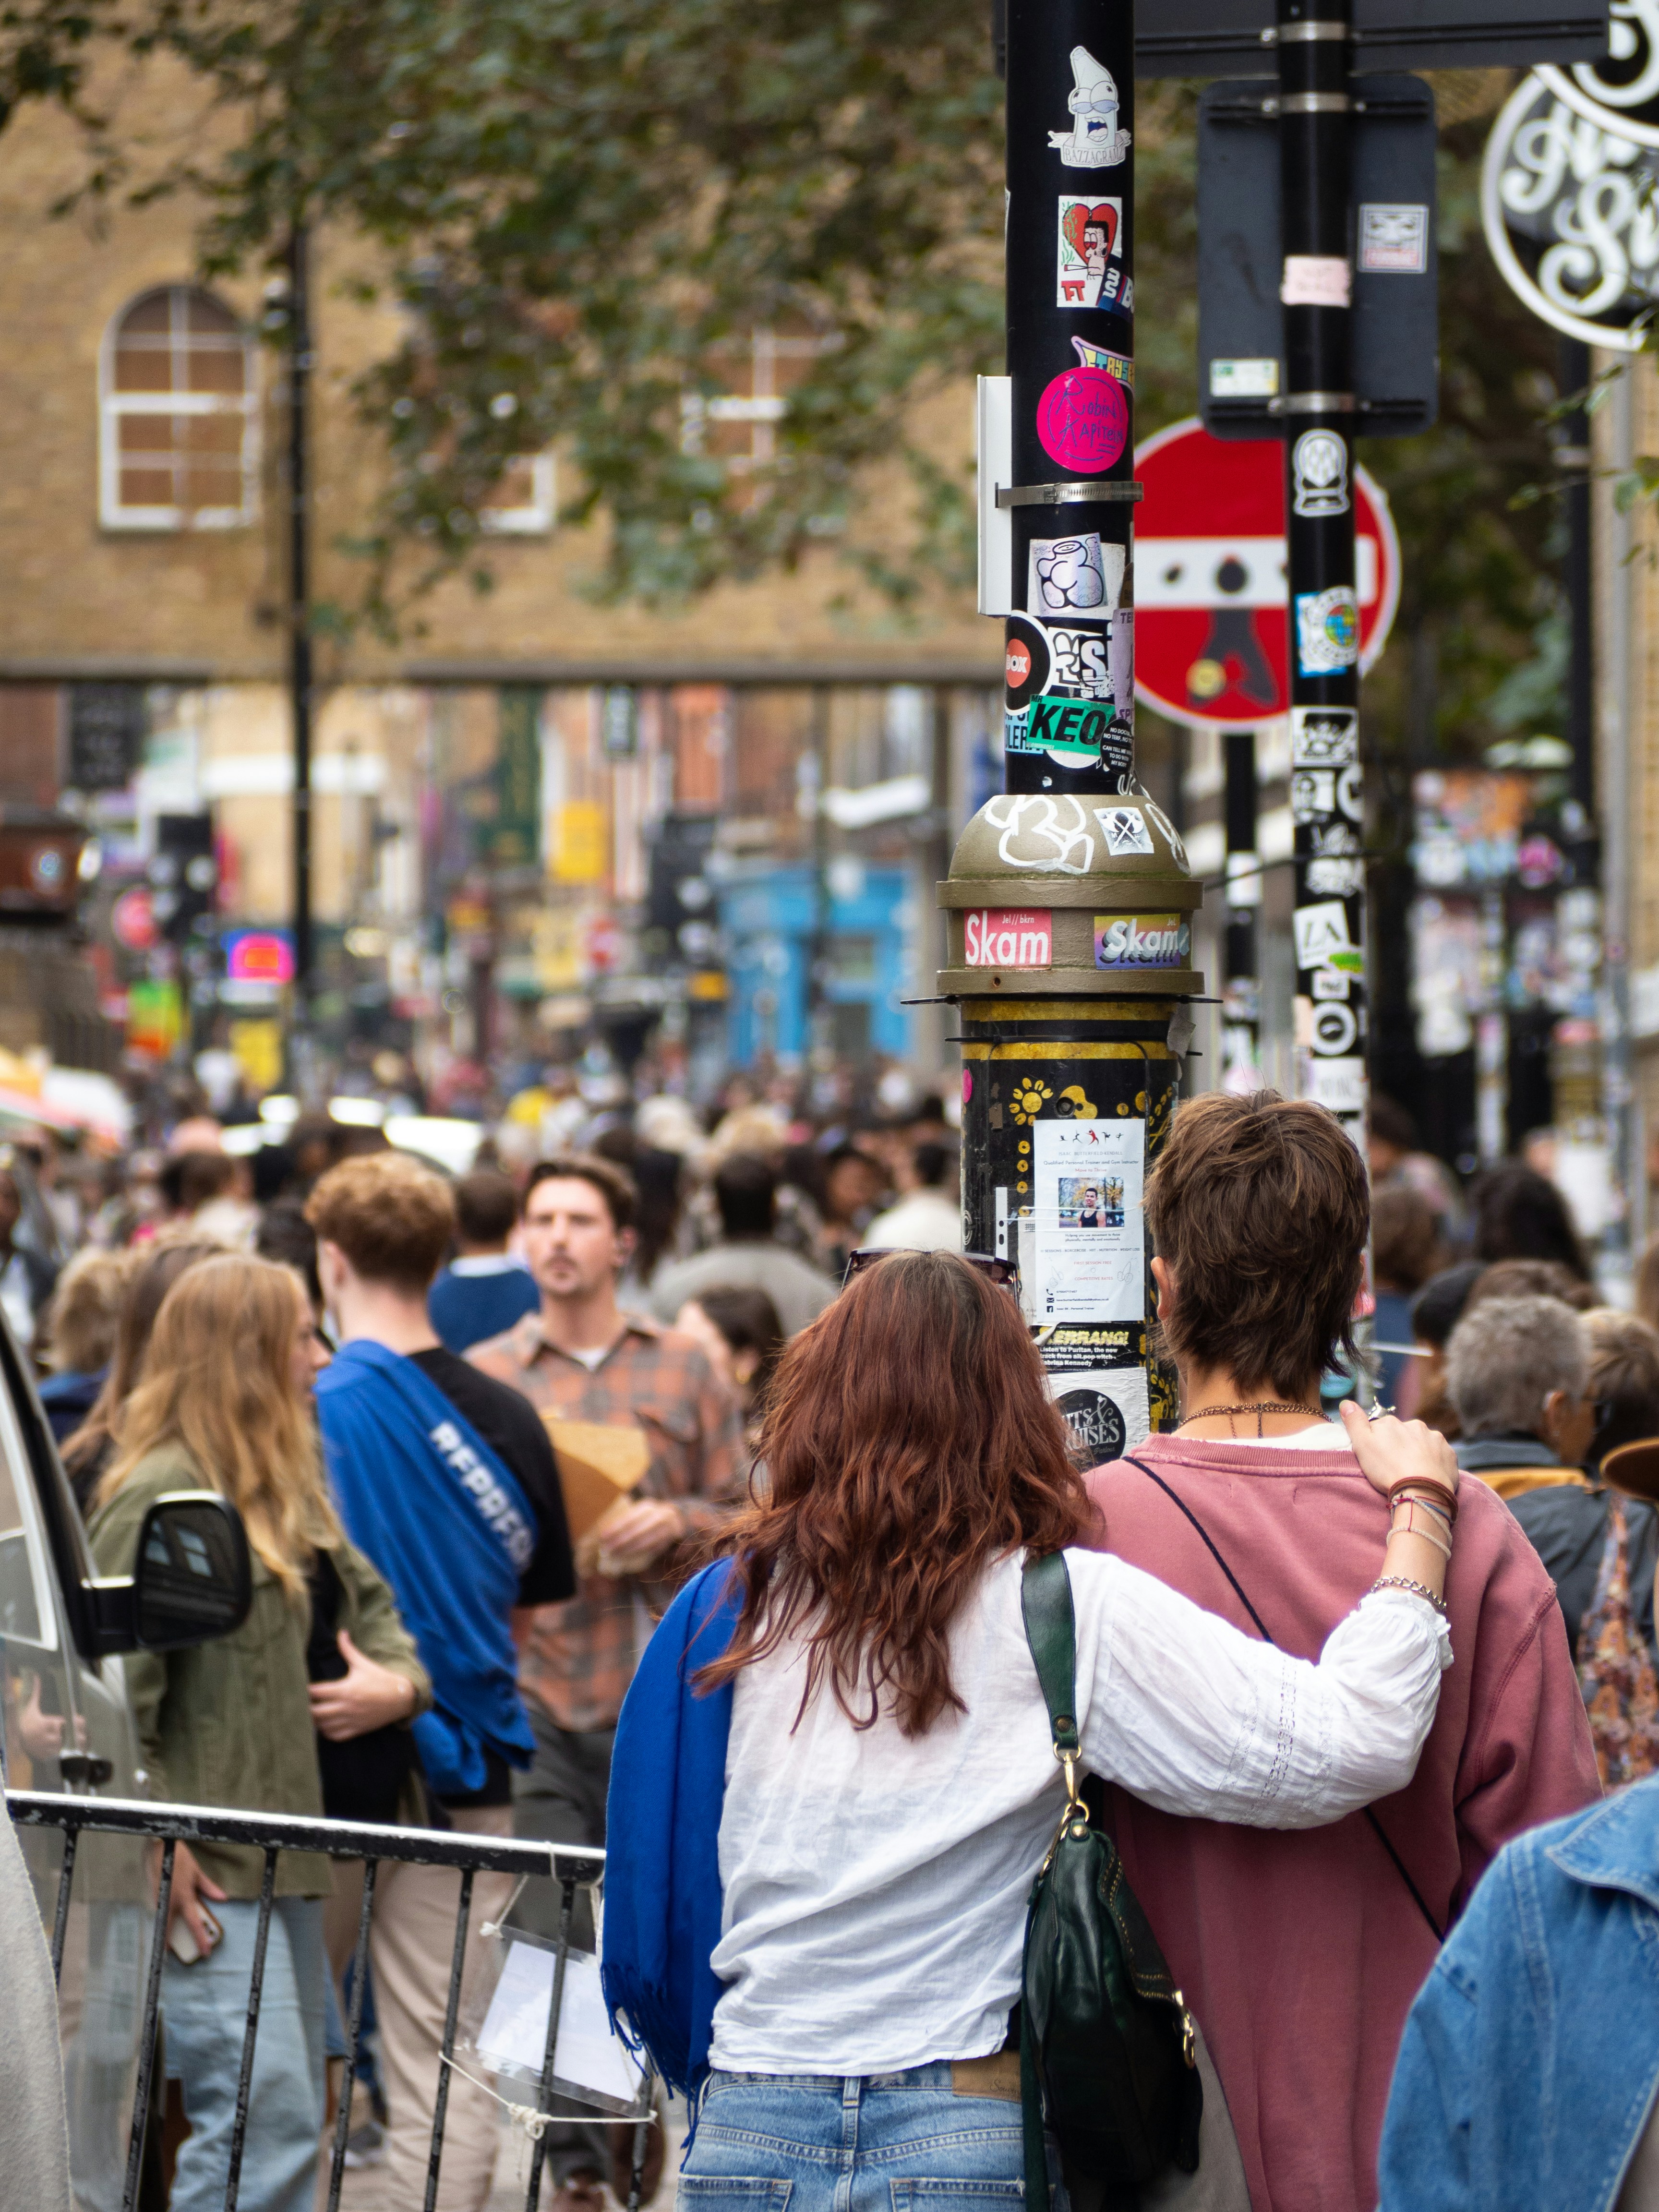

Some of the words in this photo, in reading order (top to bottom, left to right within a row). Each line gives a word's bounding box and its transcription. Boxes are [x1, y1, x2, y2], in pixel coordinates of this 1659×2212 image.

[965, 910, 1049, 965] Skam
[1104, 918, 1179, 959] Skam
[1047, 1330, 1130, 1346] ERRANG!
